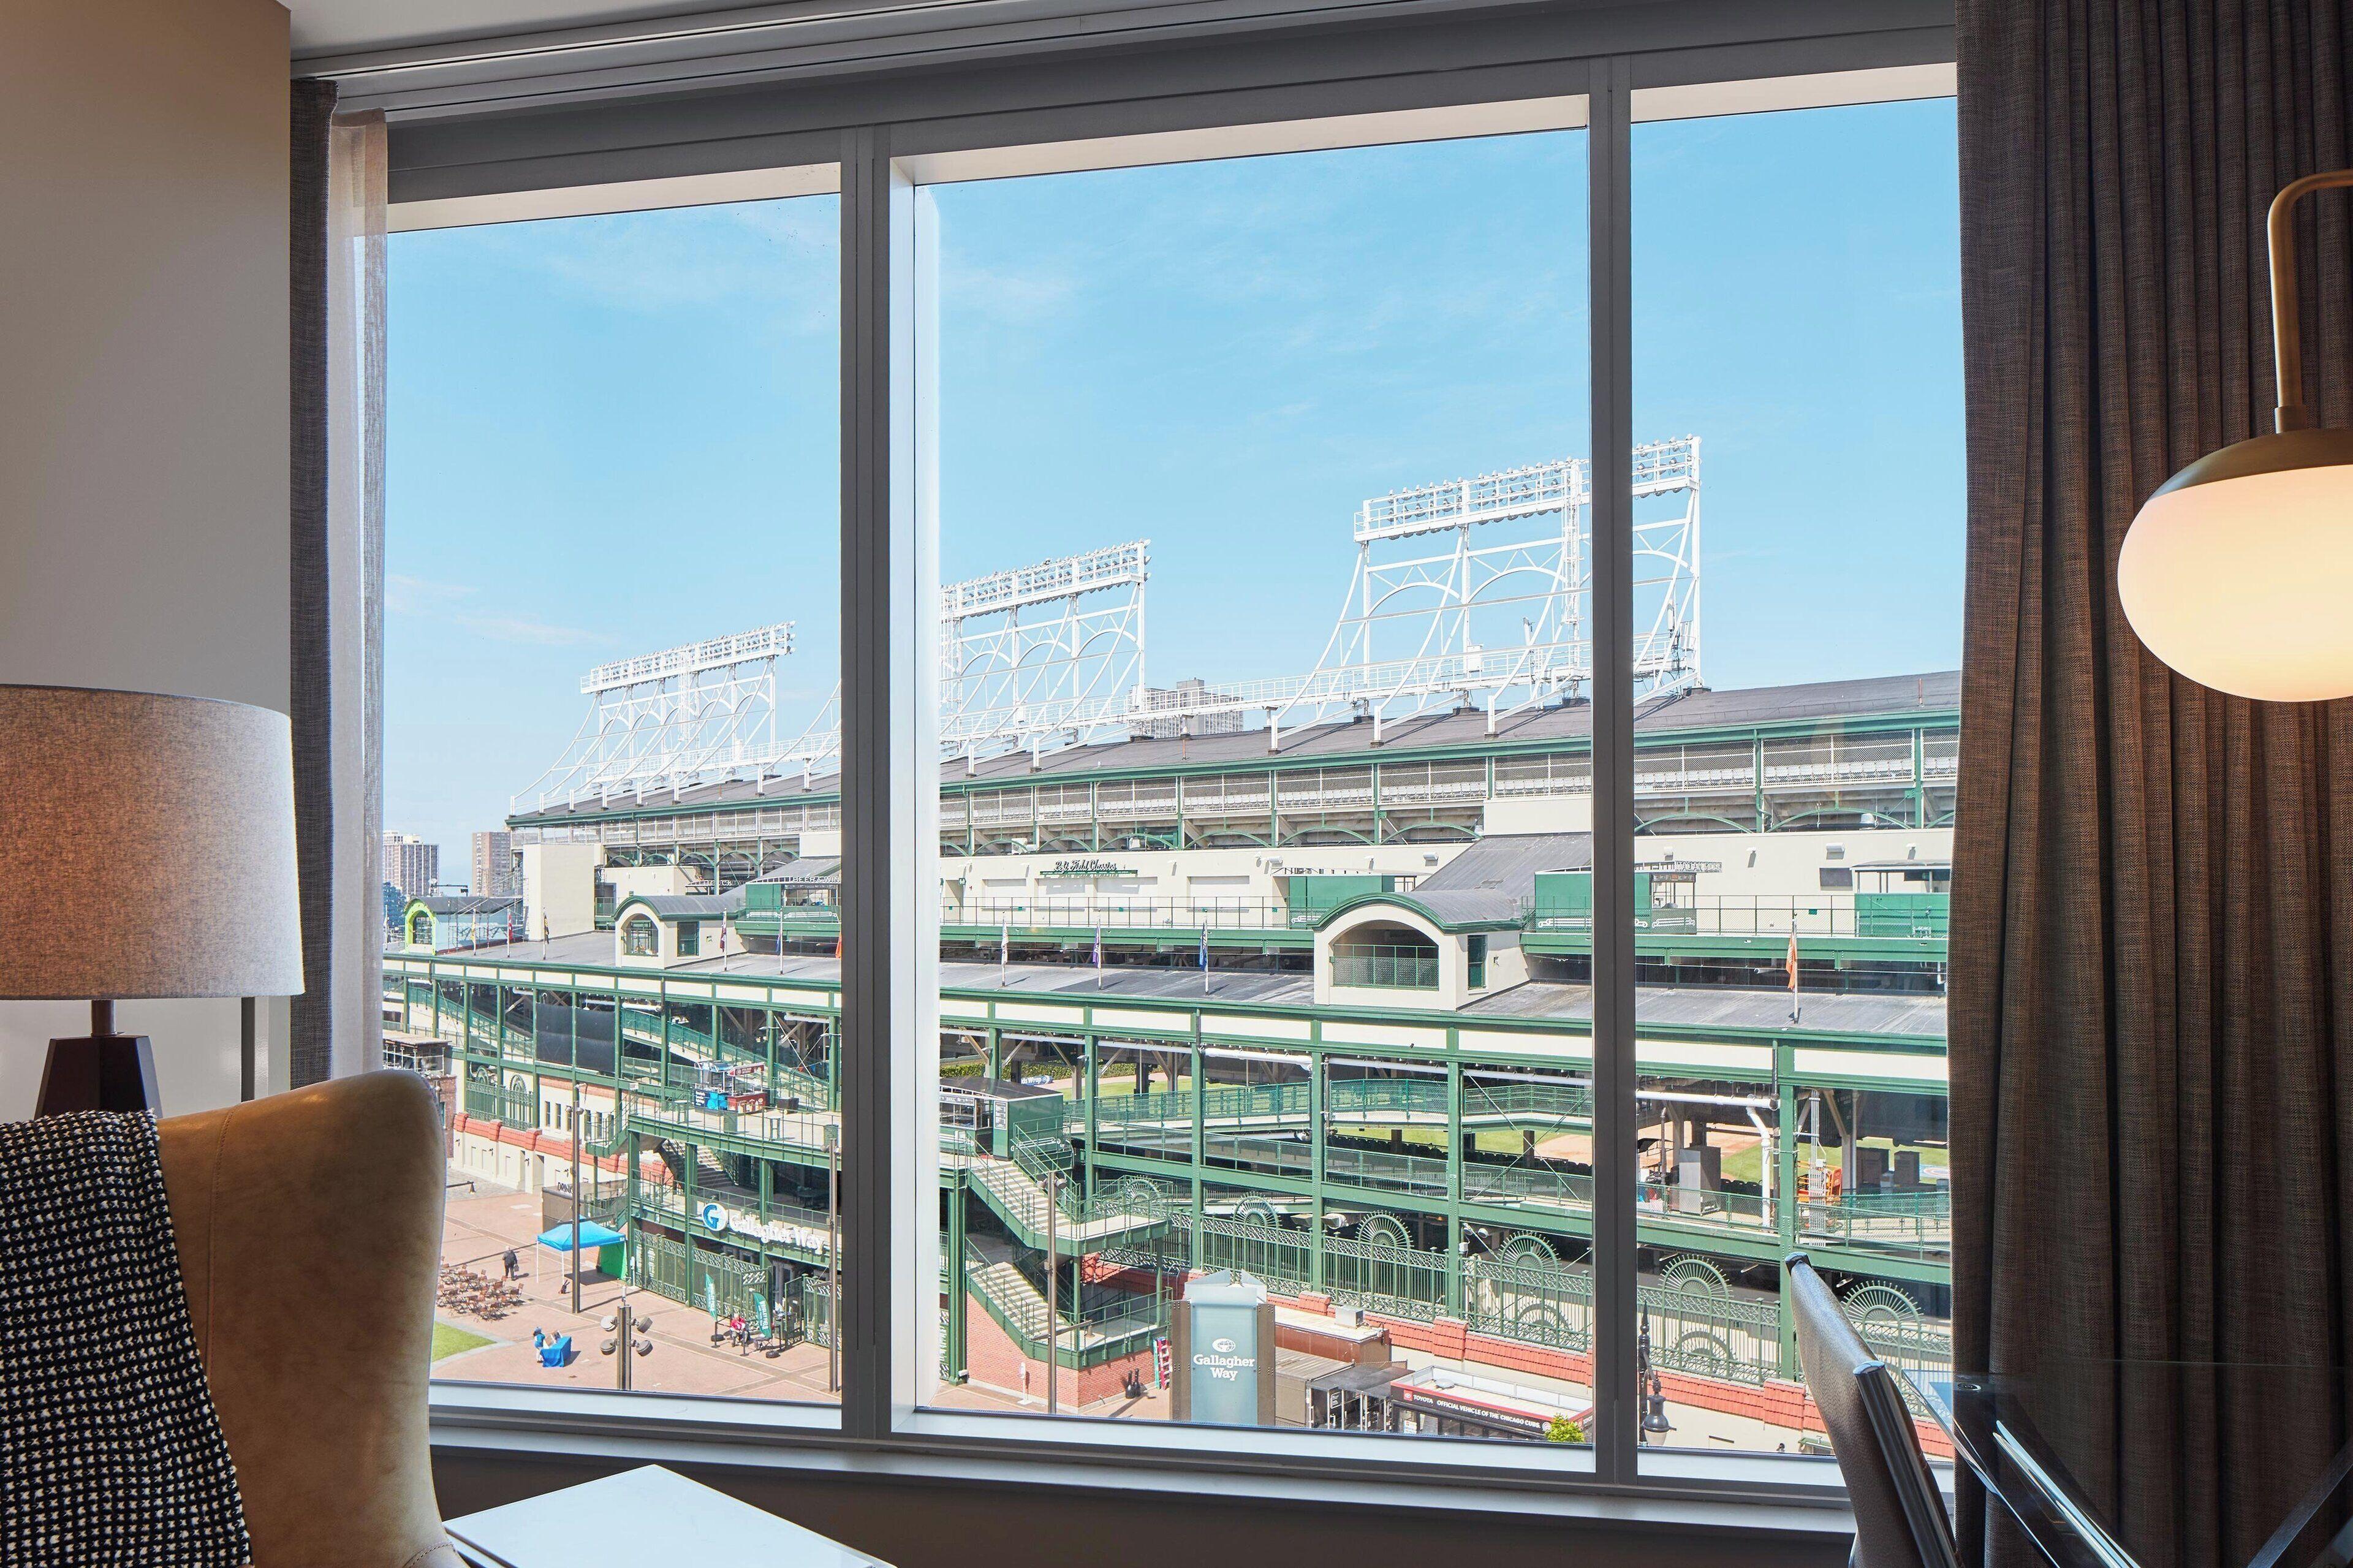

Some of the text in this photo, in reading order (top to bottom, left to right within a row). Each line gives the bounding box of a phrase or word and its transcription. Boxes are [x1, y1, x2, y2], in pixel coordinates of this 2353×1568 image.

[1070, 860, 1089, 871] Field
[1090, 859, 1117, 871] Classics
[729, 1213, 795, 1243] Gallagher
[794, 1226, 825, 1255] Way
[1193, 1354, 1255, 1368] Gallagher
[1210, 1367, 1238, 1381] Way
[1413, 1395, 1433, 1404] TOYOTA
[1436, 1400, 1460, 1410] OFFICIAL
[1460, 1406, 1481, 1415] VEHICLE
[1500, 1414, 1524, 1425] CHICAGO
